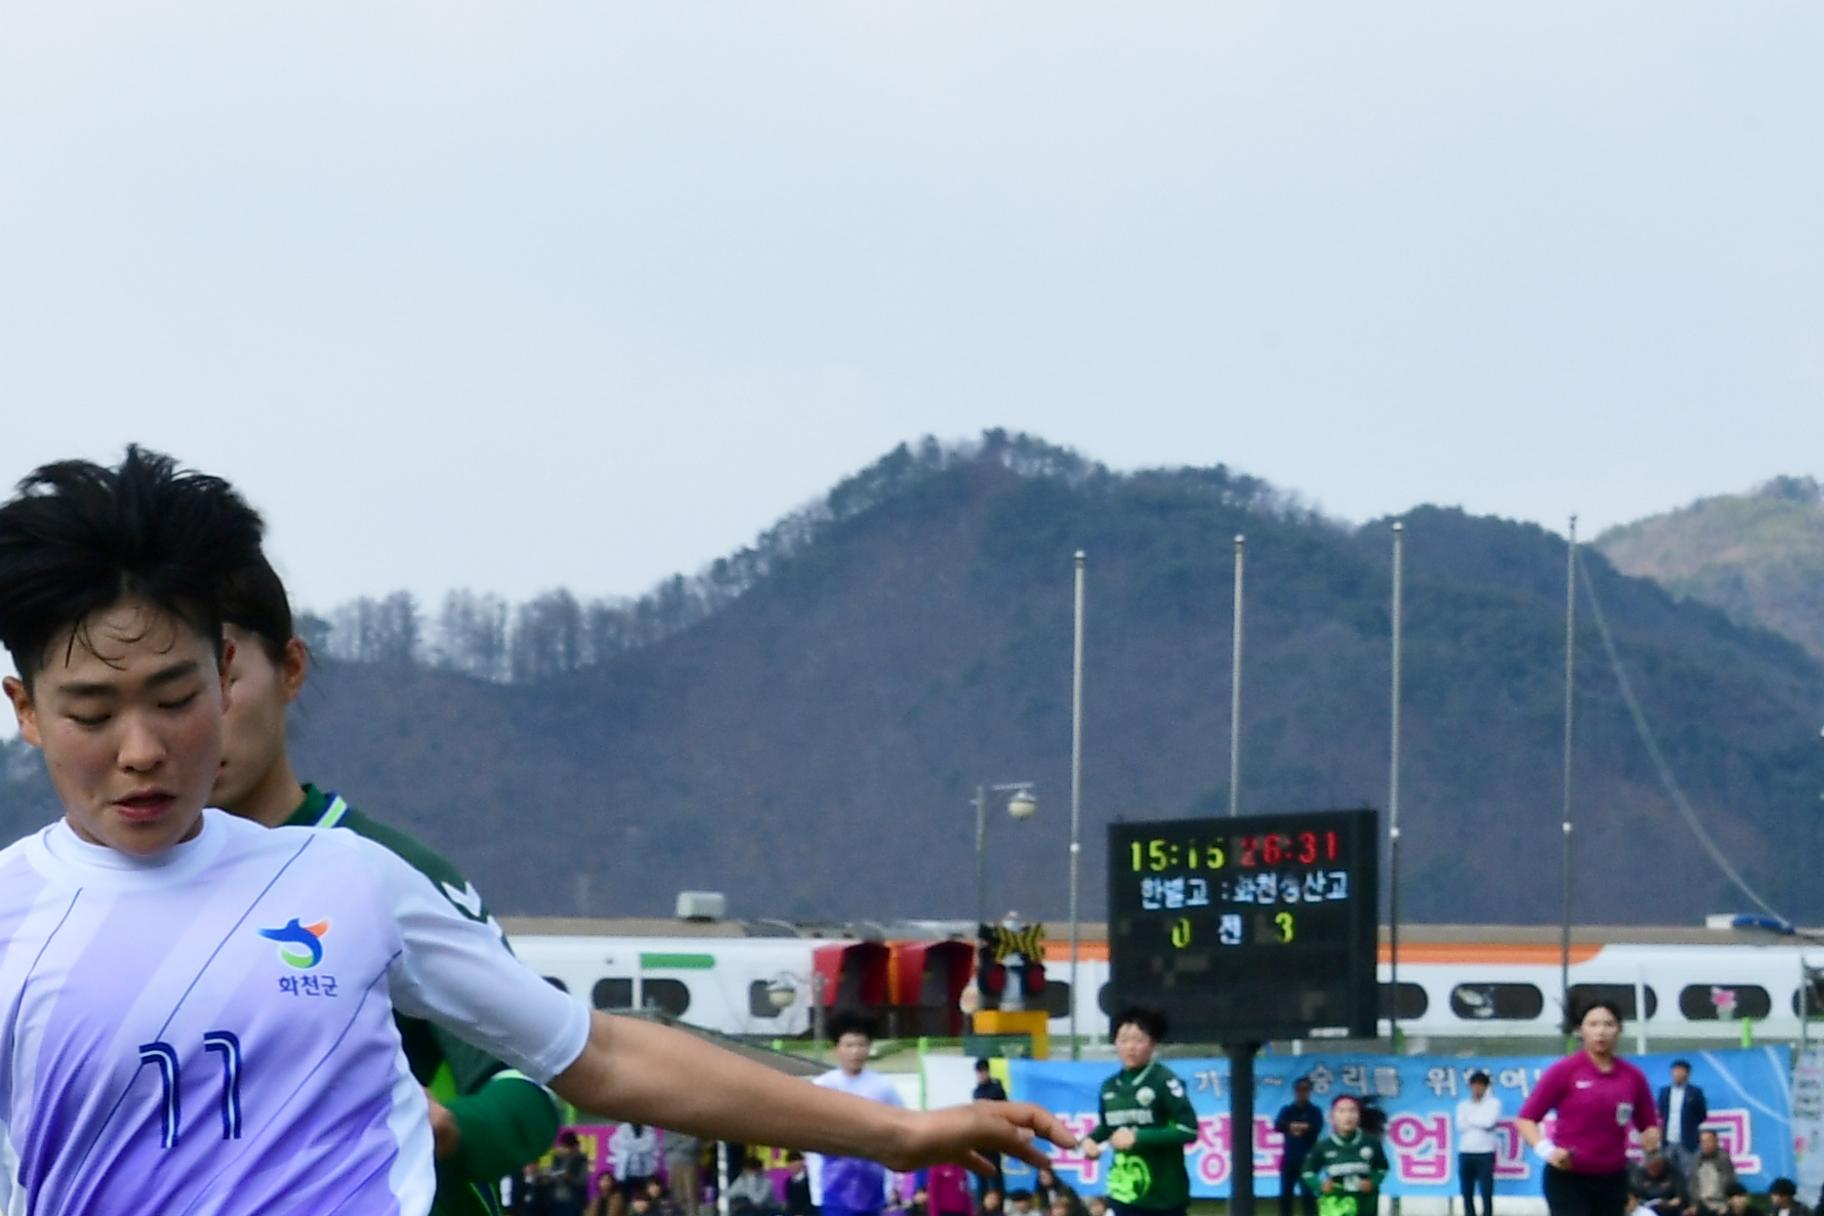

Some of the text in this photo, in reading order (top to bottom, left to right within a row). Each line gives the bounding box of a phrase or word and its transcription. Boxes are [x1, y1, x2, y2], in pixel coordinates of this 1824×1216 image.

[1275, 911, 1295, 943] 3
[278, 974, 338, 998] 화천군
[138, 1030, 242, 1148] 11
